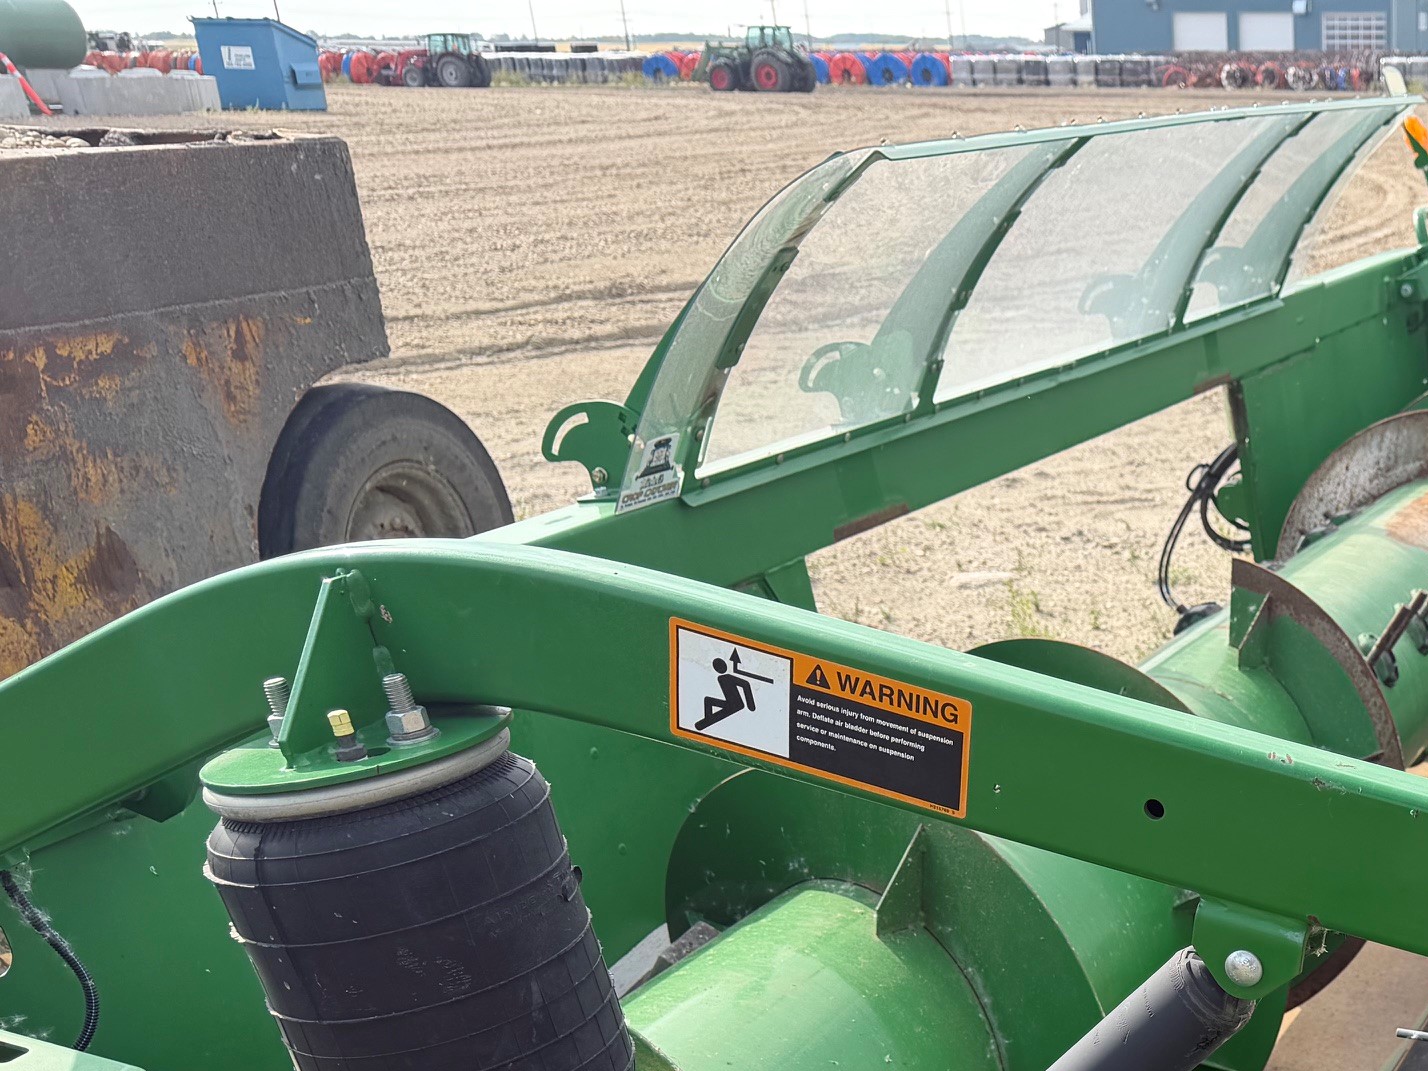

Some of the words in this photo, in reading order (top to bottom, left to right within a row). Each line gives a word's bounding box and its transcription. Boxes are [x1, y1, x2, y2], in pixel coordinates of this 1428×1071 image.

[836, 671, 959, 725] WARNING
[796, 709, 810, 718] arm.
[812, 712, 834, 724] Deflate
[835, 719, 844, 727] air
[844, 721, 868, 735] bladder
[870, 729, 890, 741] before
[890, 735, 925, 752] performing
[796, 722, 819, 733] service
[828, 731, 868, 747] maintenance
[878, 746, 914, 761] suspension
[797, 694, 815, 706] Avoid
[816, 702, 840, 712] serious
[841, 706, 859, 719] injury
[860, 712, 875, 723] from
[876, 718, 909, 733] movement
[910, 727, 917, 735] of
[918, 730, 954, 746] suspension
[796, 735, 836, 752] components.
